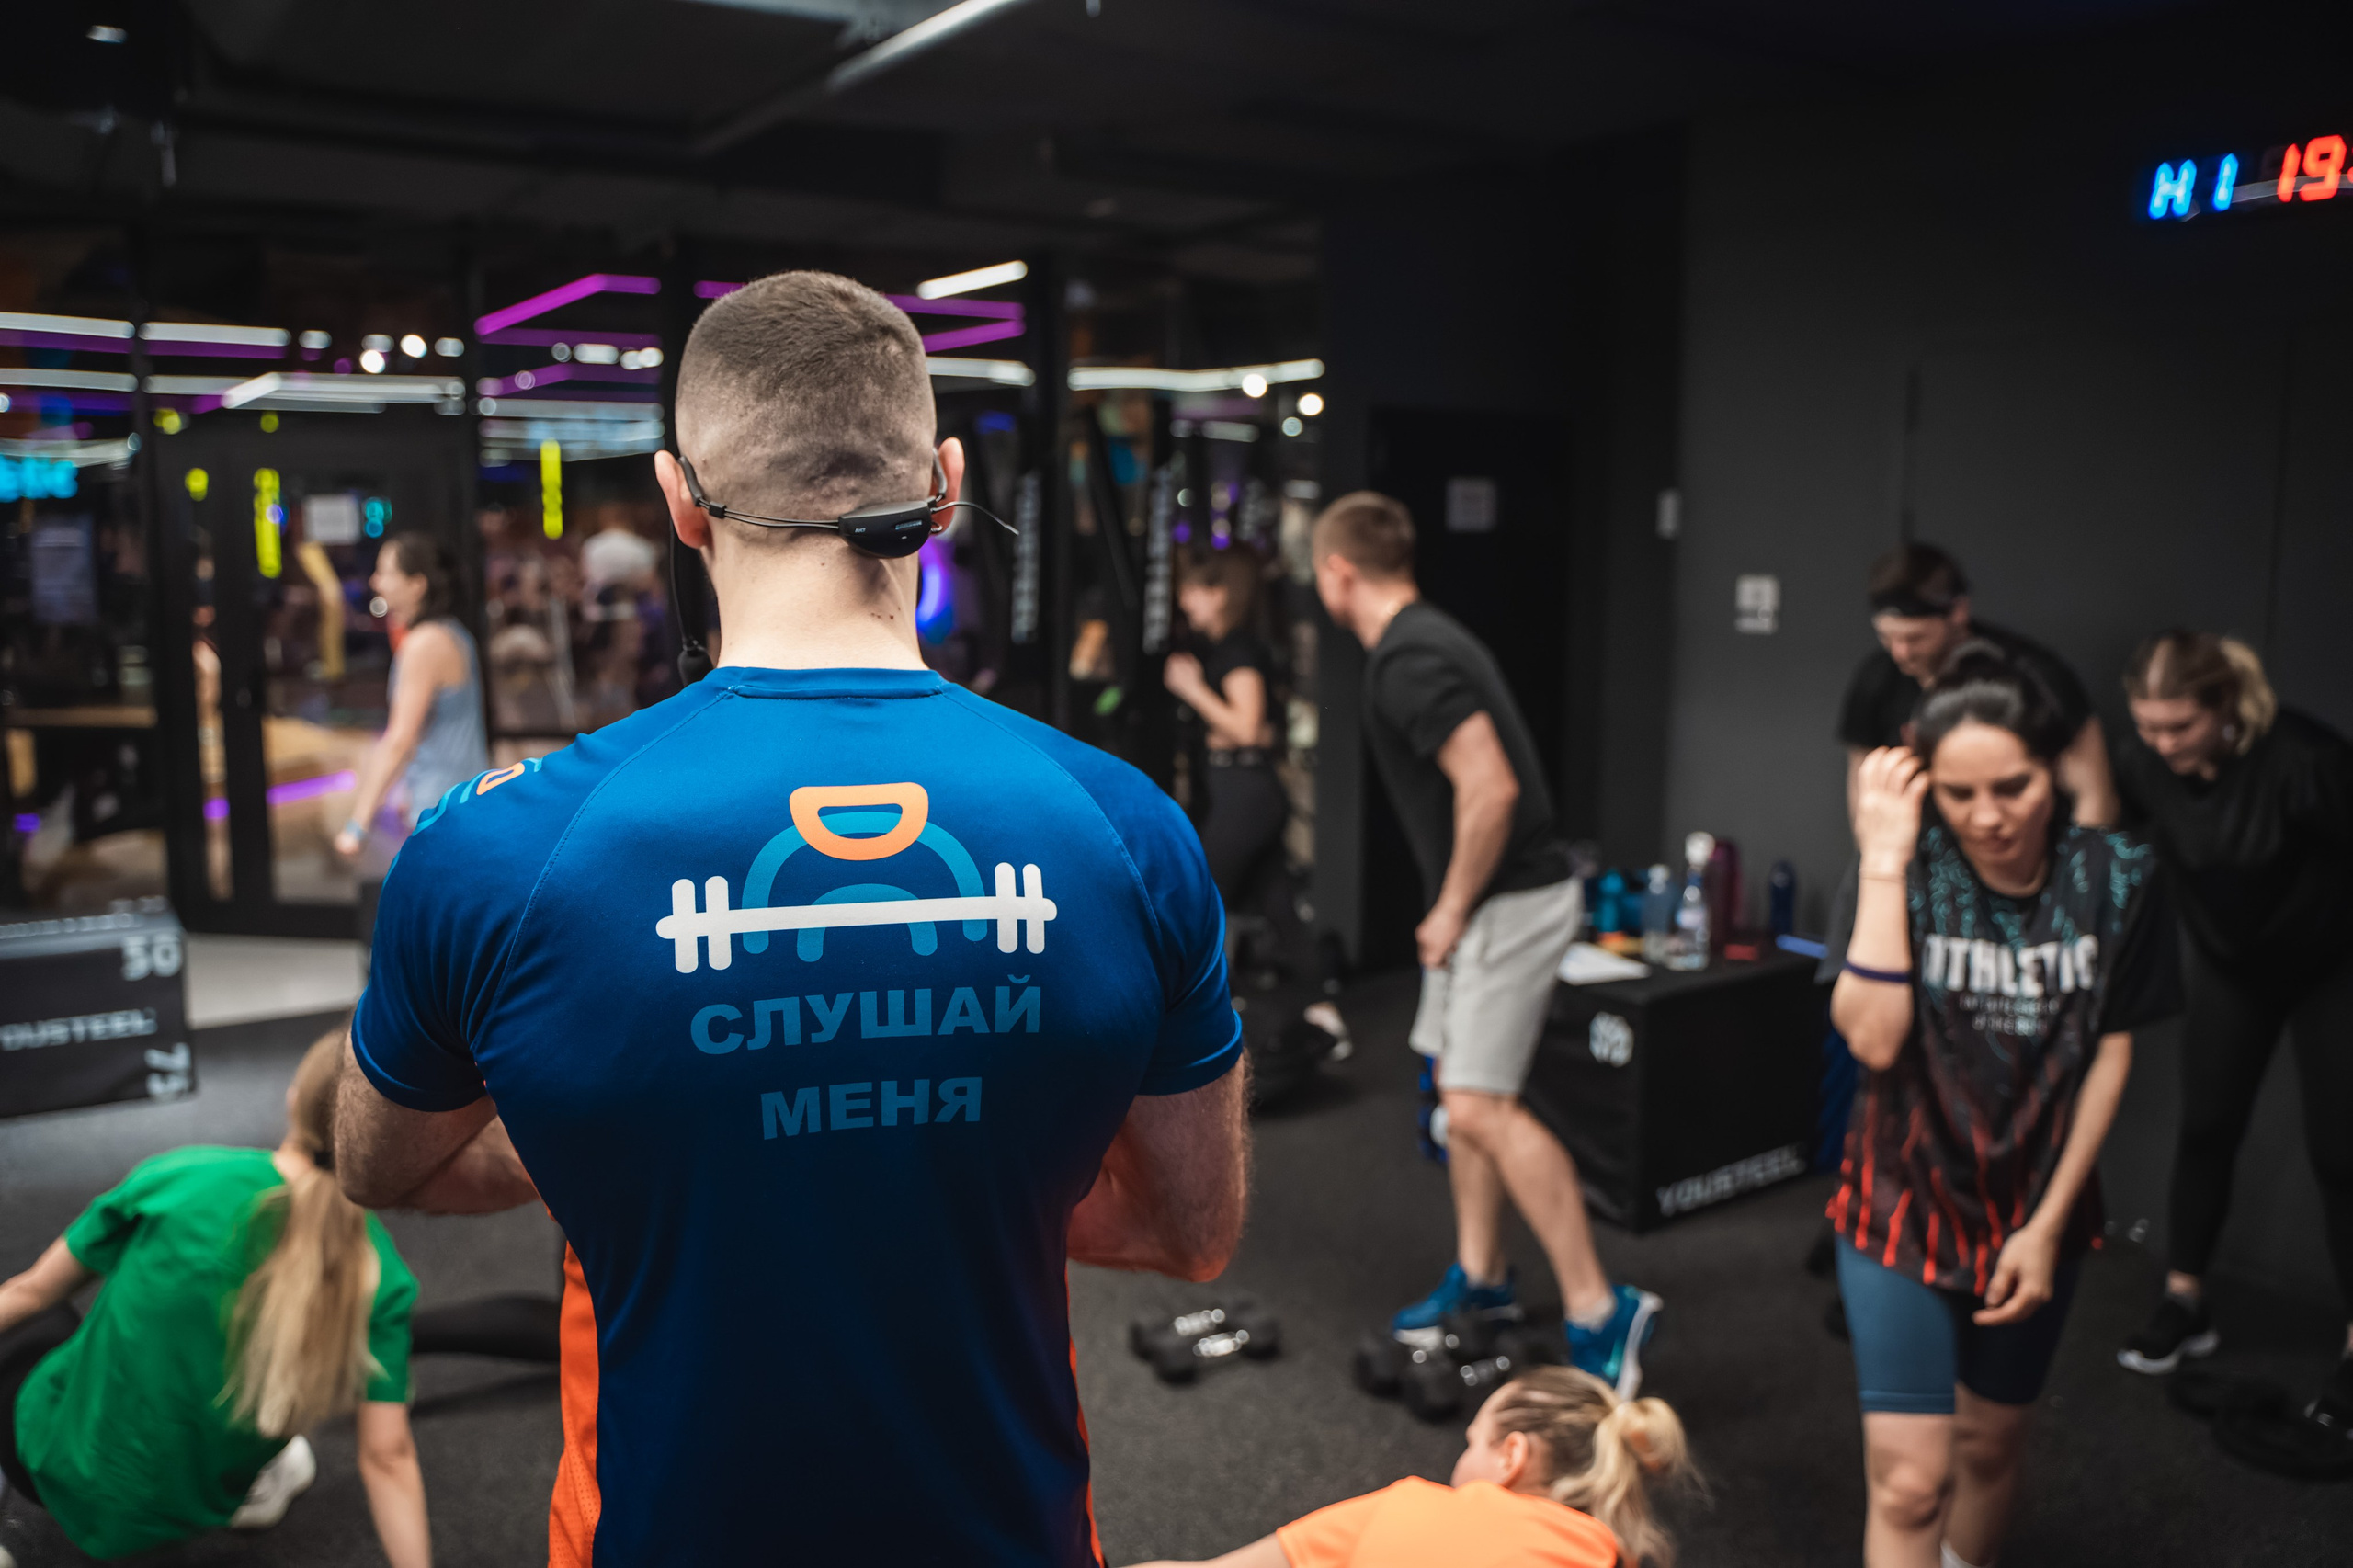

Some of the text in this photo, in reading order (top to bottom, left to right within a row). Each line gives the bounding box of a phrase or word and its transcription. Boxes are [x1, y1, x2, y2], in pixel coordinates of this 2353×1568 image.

[0, 1008, 157, 1051] OUSTEEL
[690, 974, 1041, 1054] СЛУШАЙ
[760, 1076, 983, 1140] МЕНЯ
